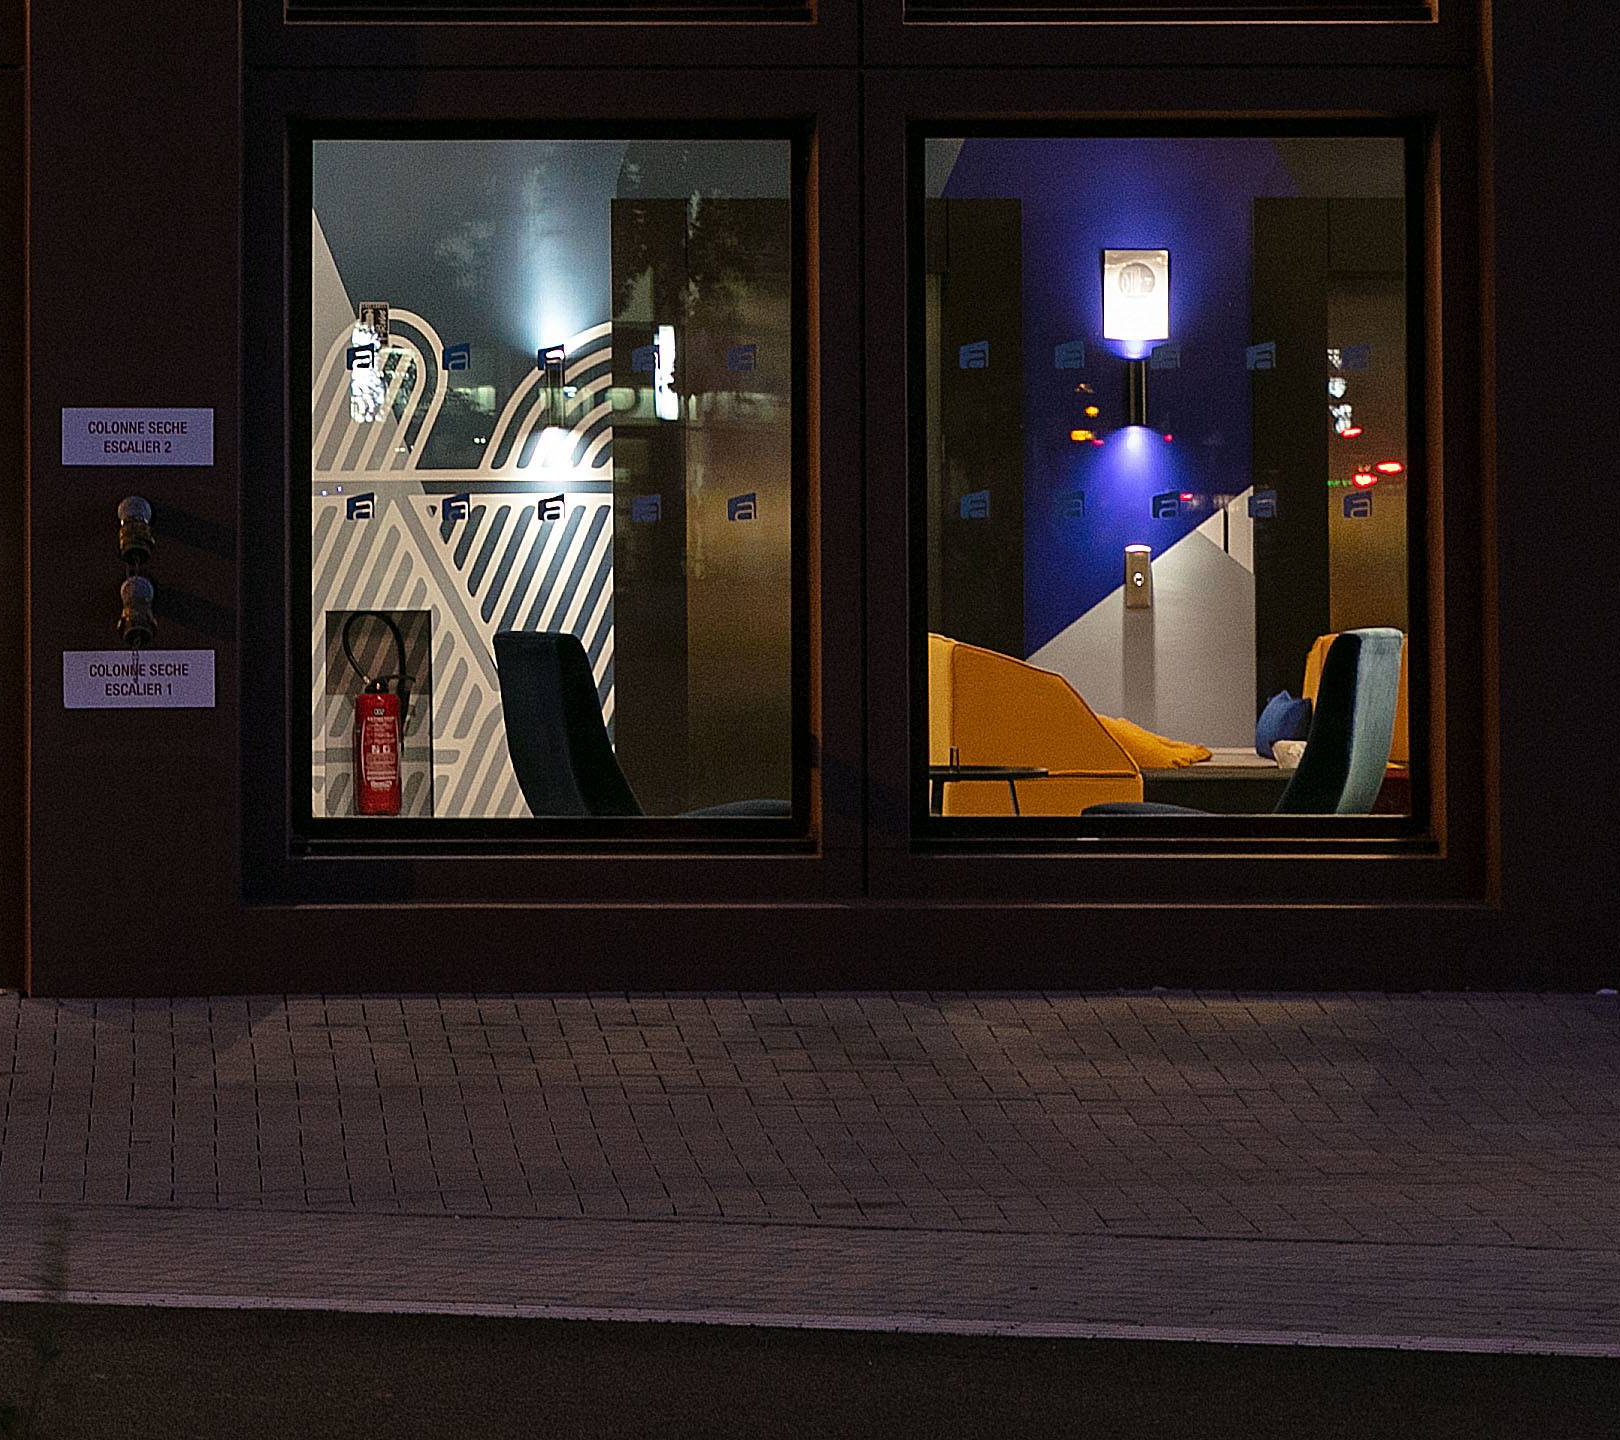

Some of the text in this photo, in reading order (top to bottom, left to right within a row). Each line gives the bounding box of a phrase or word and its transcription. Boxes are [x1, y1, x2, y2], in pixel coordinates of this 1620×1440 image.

[88, 421, 188, 435] COLONNE SECHE
[103, 440, 172, 454] ESCALIER 2
[89, 663, 189, 678] COLONNE SECHE
[105, 683, 173, 697] ESCALIER 1
